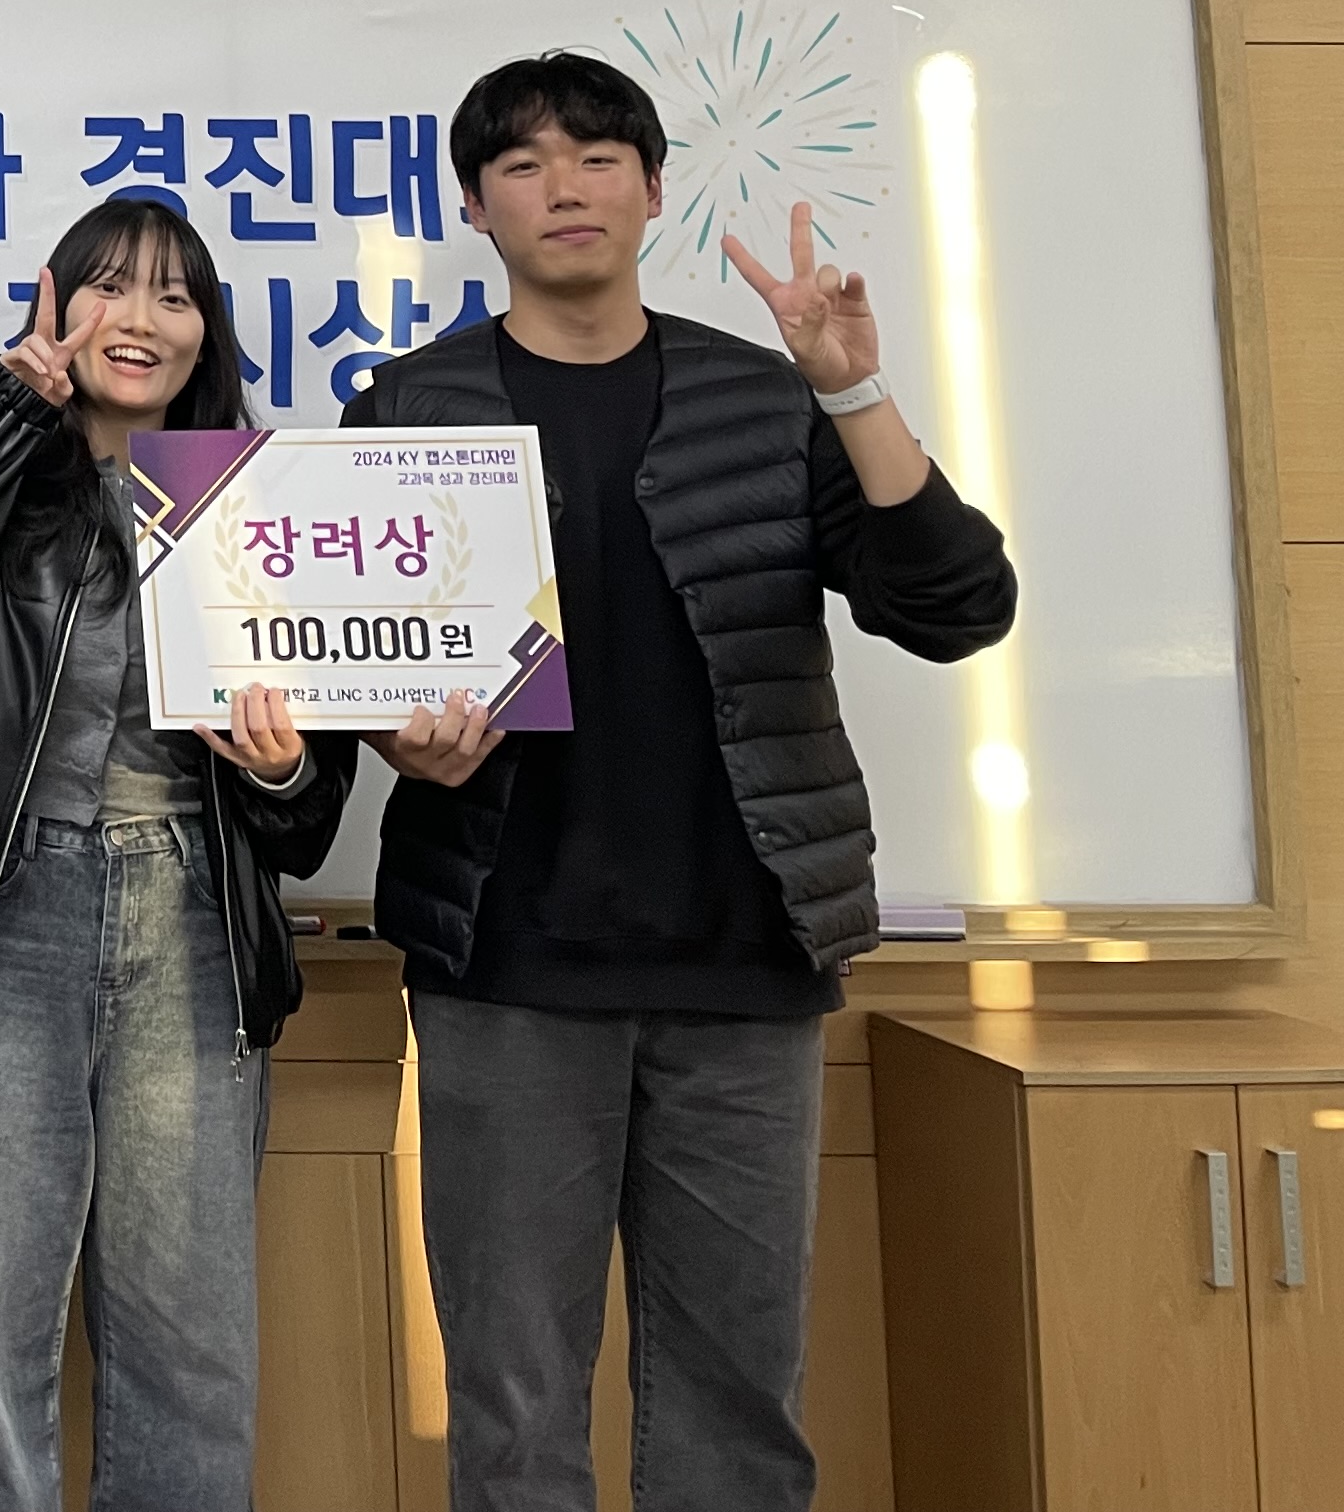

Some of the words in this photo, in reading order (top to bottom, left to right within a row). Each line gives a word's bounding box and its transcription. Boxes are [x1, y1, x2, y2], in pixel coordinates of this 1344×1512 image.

[80, 112, 470, 243] 경진대
[353, 451, 393, 466] 2024
[397, 451, 419, 466] KY
[425, 449, 516, 466] 캡스톤디자인
[243, 514, 434, 578] 장려상
[241, 617, 430, 663] 100,000
[440, 624, 474, 659] 원
[328, 688, 362, 702] LINC
[369, 687, 437, 704] 3.0사업단
